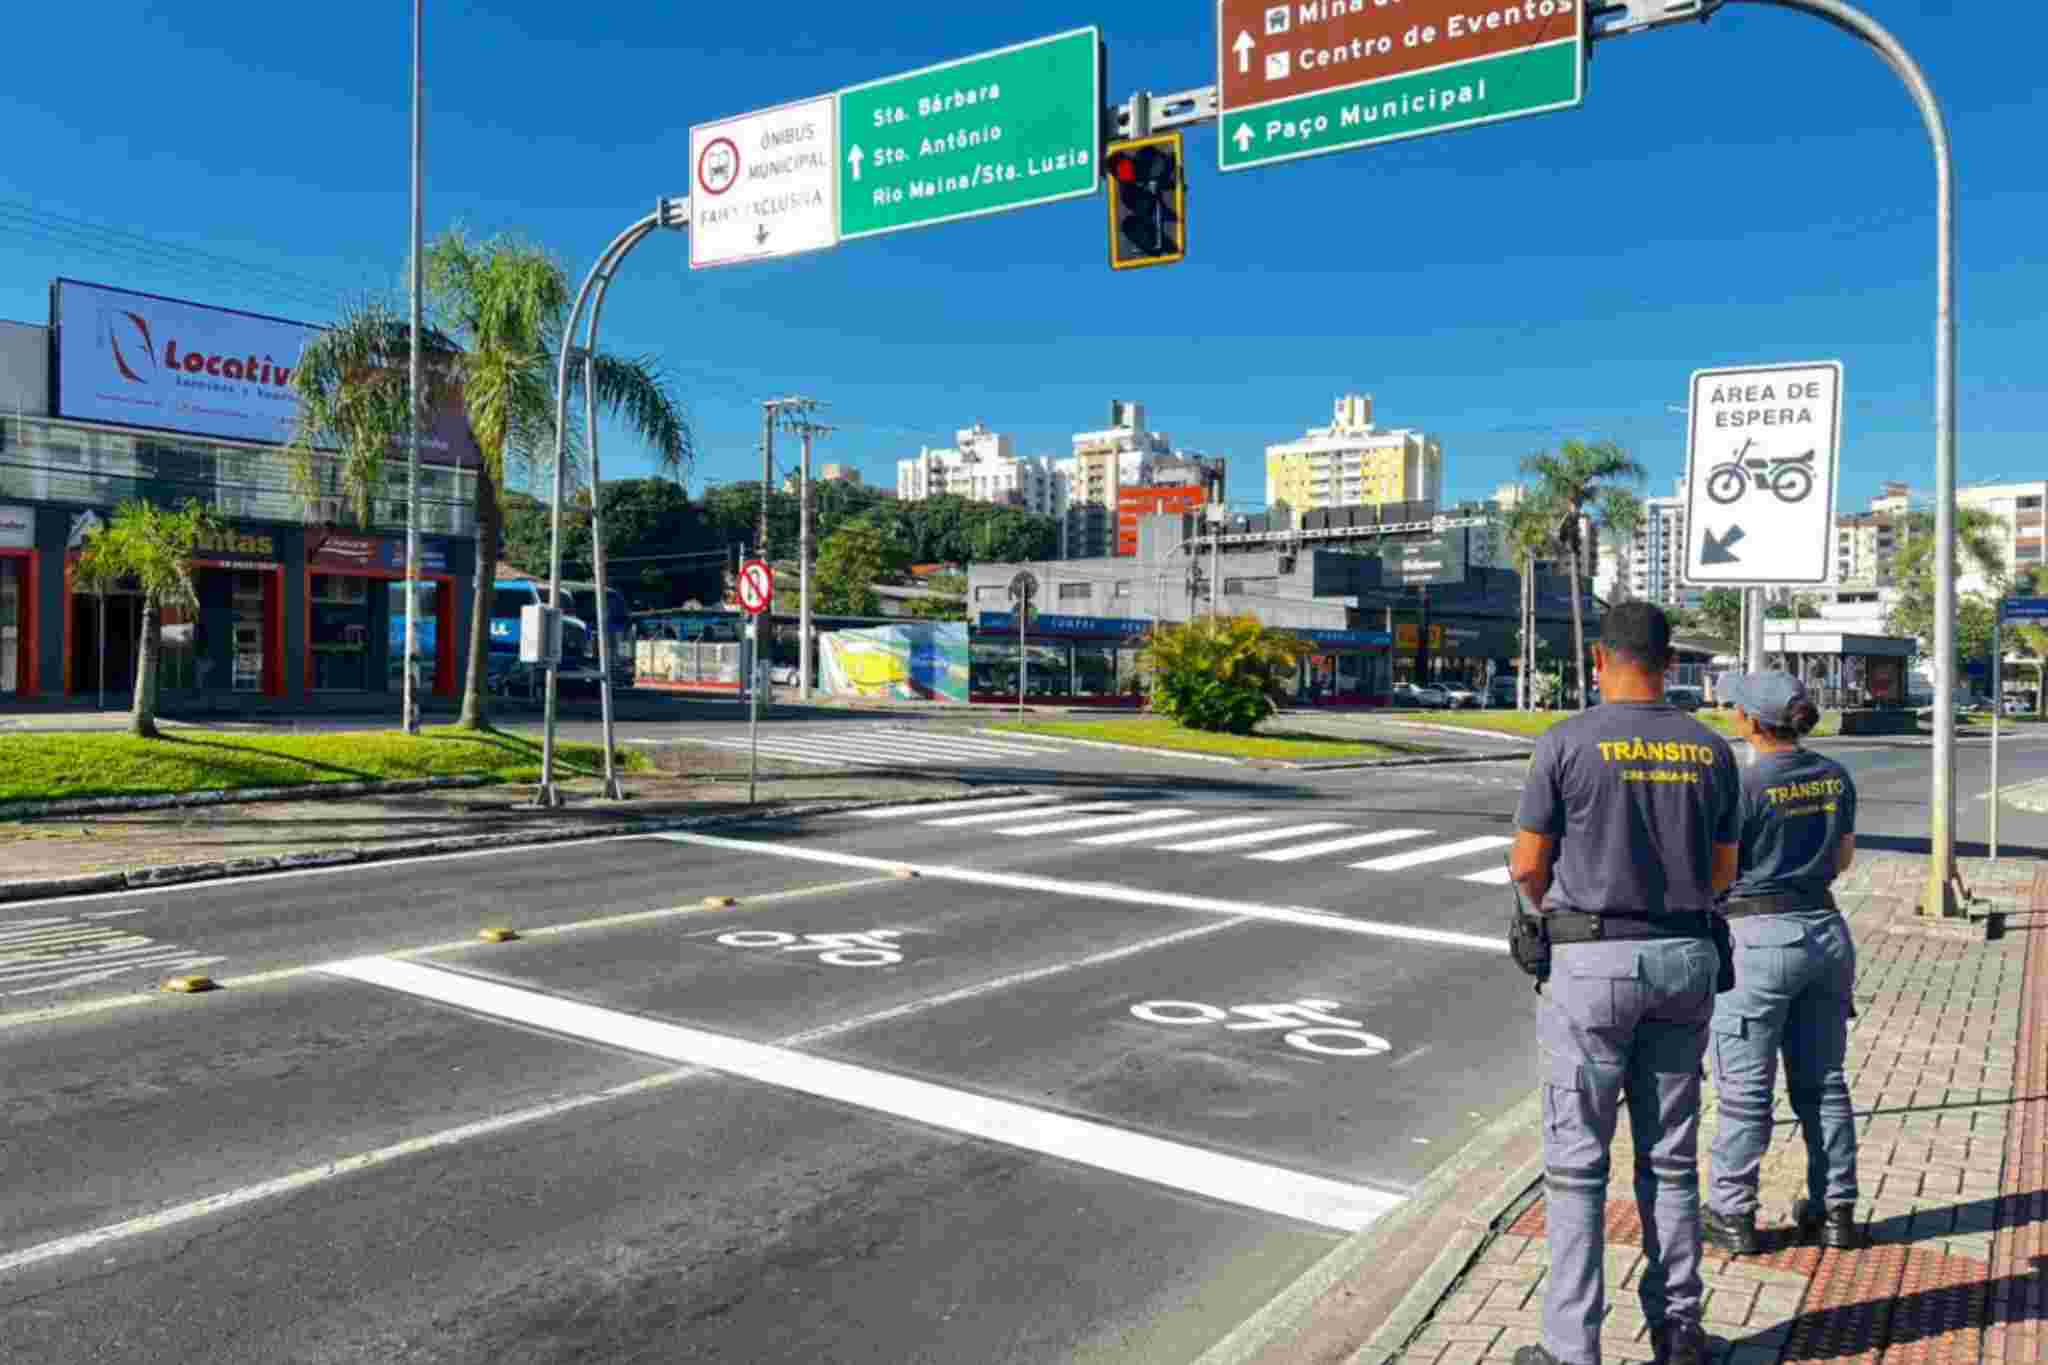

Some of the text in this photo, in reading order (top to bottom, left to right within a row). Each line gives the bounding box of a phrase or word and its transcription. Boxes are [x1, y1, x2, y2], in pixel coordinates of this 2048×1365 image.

[1299, 0, 1574, 70] Centro de Eventos
[918, 84, 1000, 116] Bárbara
[1265, 79, 1487, 142] Paço Municipal
[919, 125, 1002, 156] Antônio
[748, 151, 827, 180] MUNICIPAL
[872, 186, 903, 207] Rio
[1026, 150, 1090, 176] Luzia
[165, 339, 292, 386] Locativ
[1710, 382, 1820, 404] ÁREA DE
[1715, 407, 1812, 428] ESPERA
[1597, 736, 1713, 766] TRÂNSITO
[1766, 776, 1845, 803] TRÂNSITO
